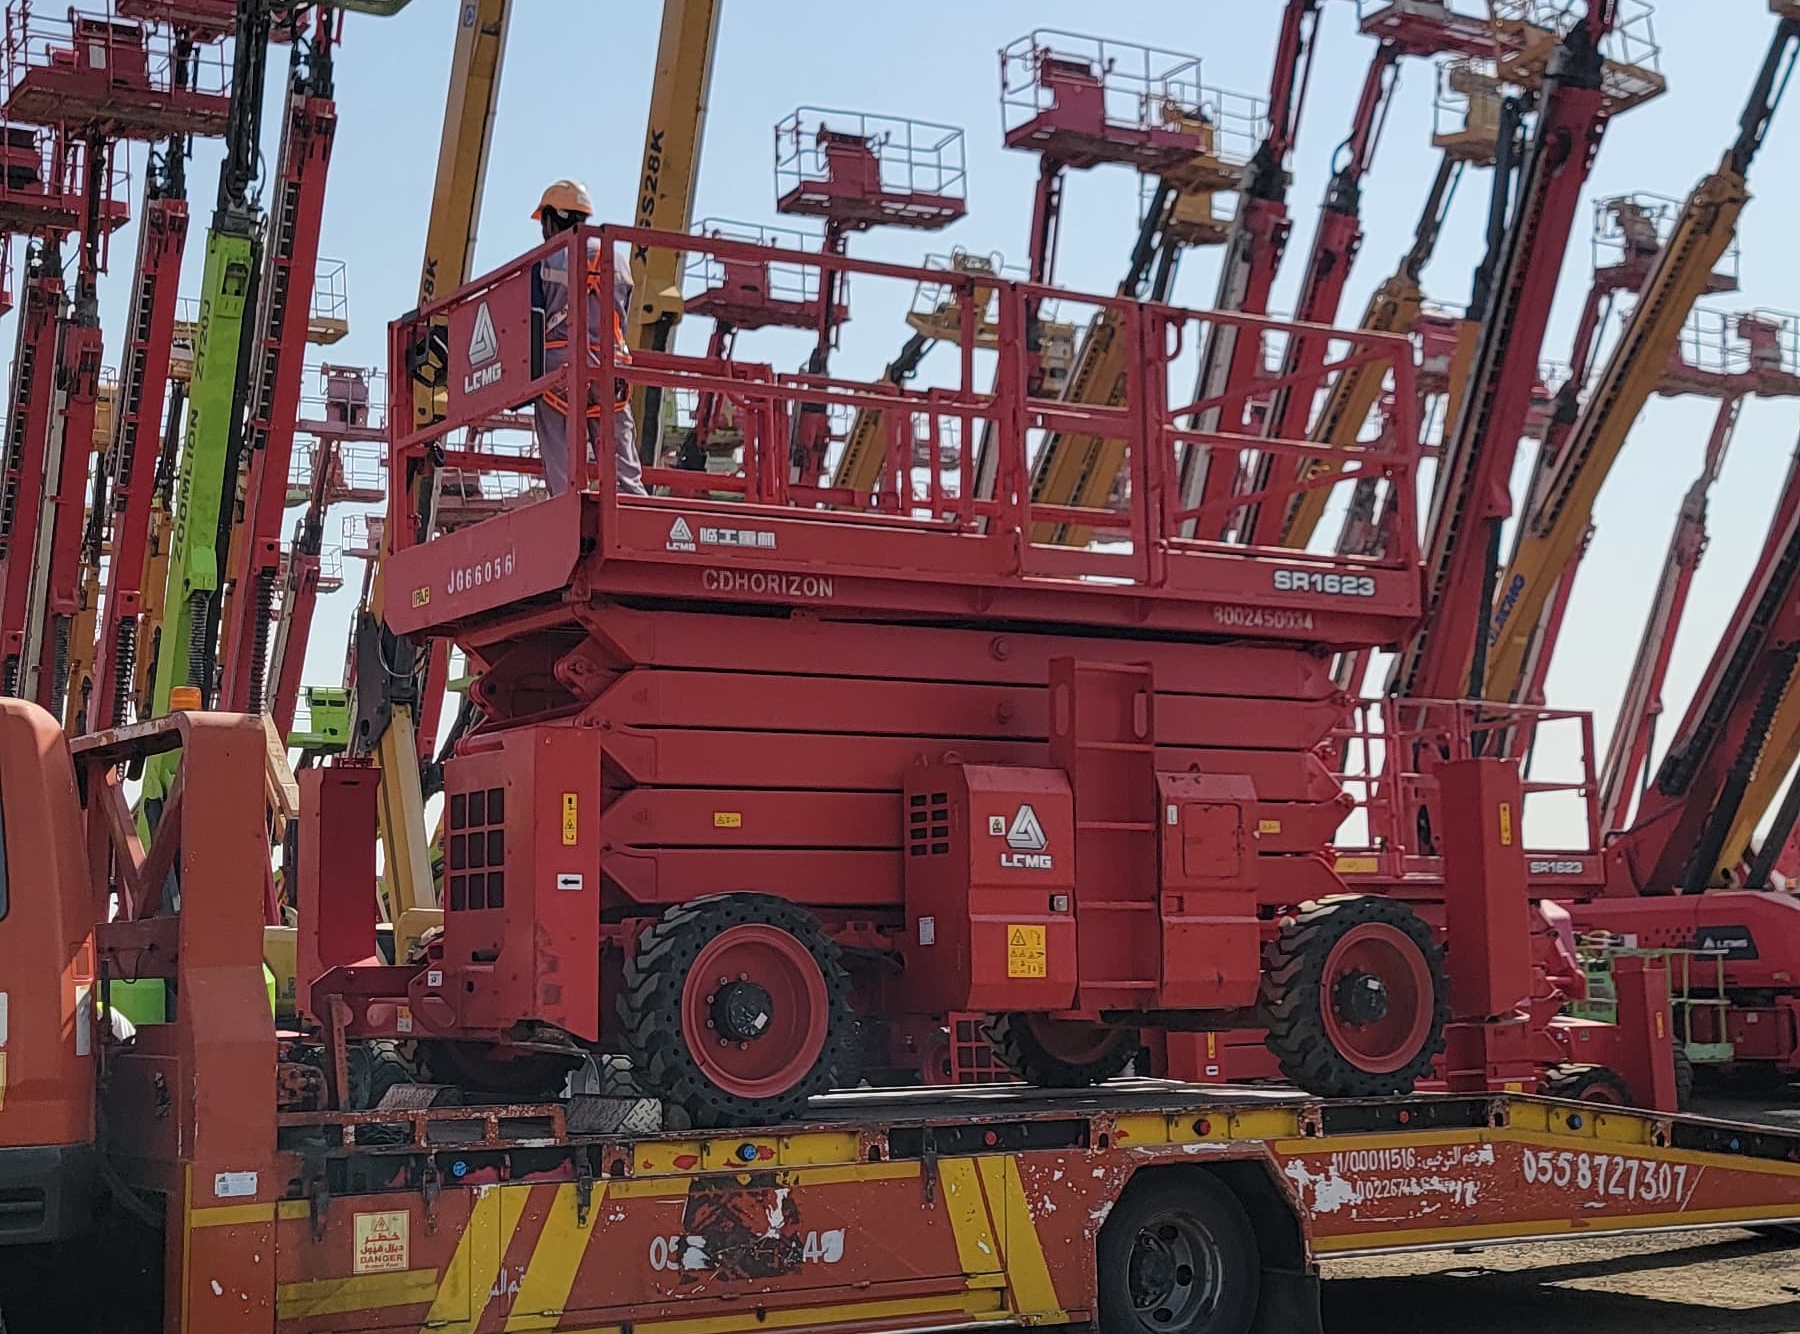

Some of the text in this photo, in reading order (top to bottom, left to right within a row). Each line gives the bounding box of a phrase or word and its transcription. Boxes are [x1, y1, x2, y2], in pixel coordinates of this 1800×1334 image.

[195, 299, 211, 381] ZT20J
[173, 409, 199, 561] ZOOMLION
[702, 569, 834, 598] CDHORIZON
[1273, 569, 1376, 597] SR1623
[1529, 861, 1584, 874] SR1623
[1523, 1148, 1688, 1203] 0558727307
[364, 1231, 400, 1244] خطر
[360, 1254, 403, 1264] DANGER
